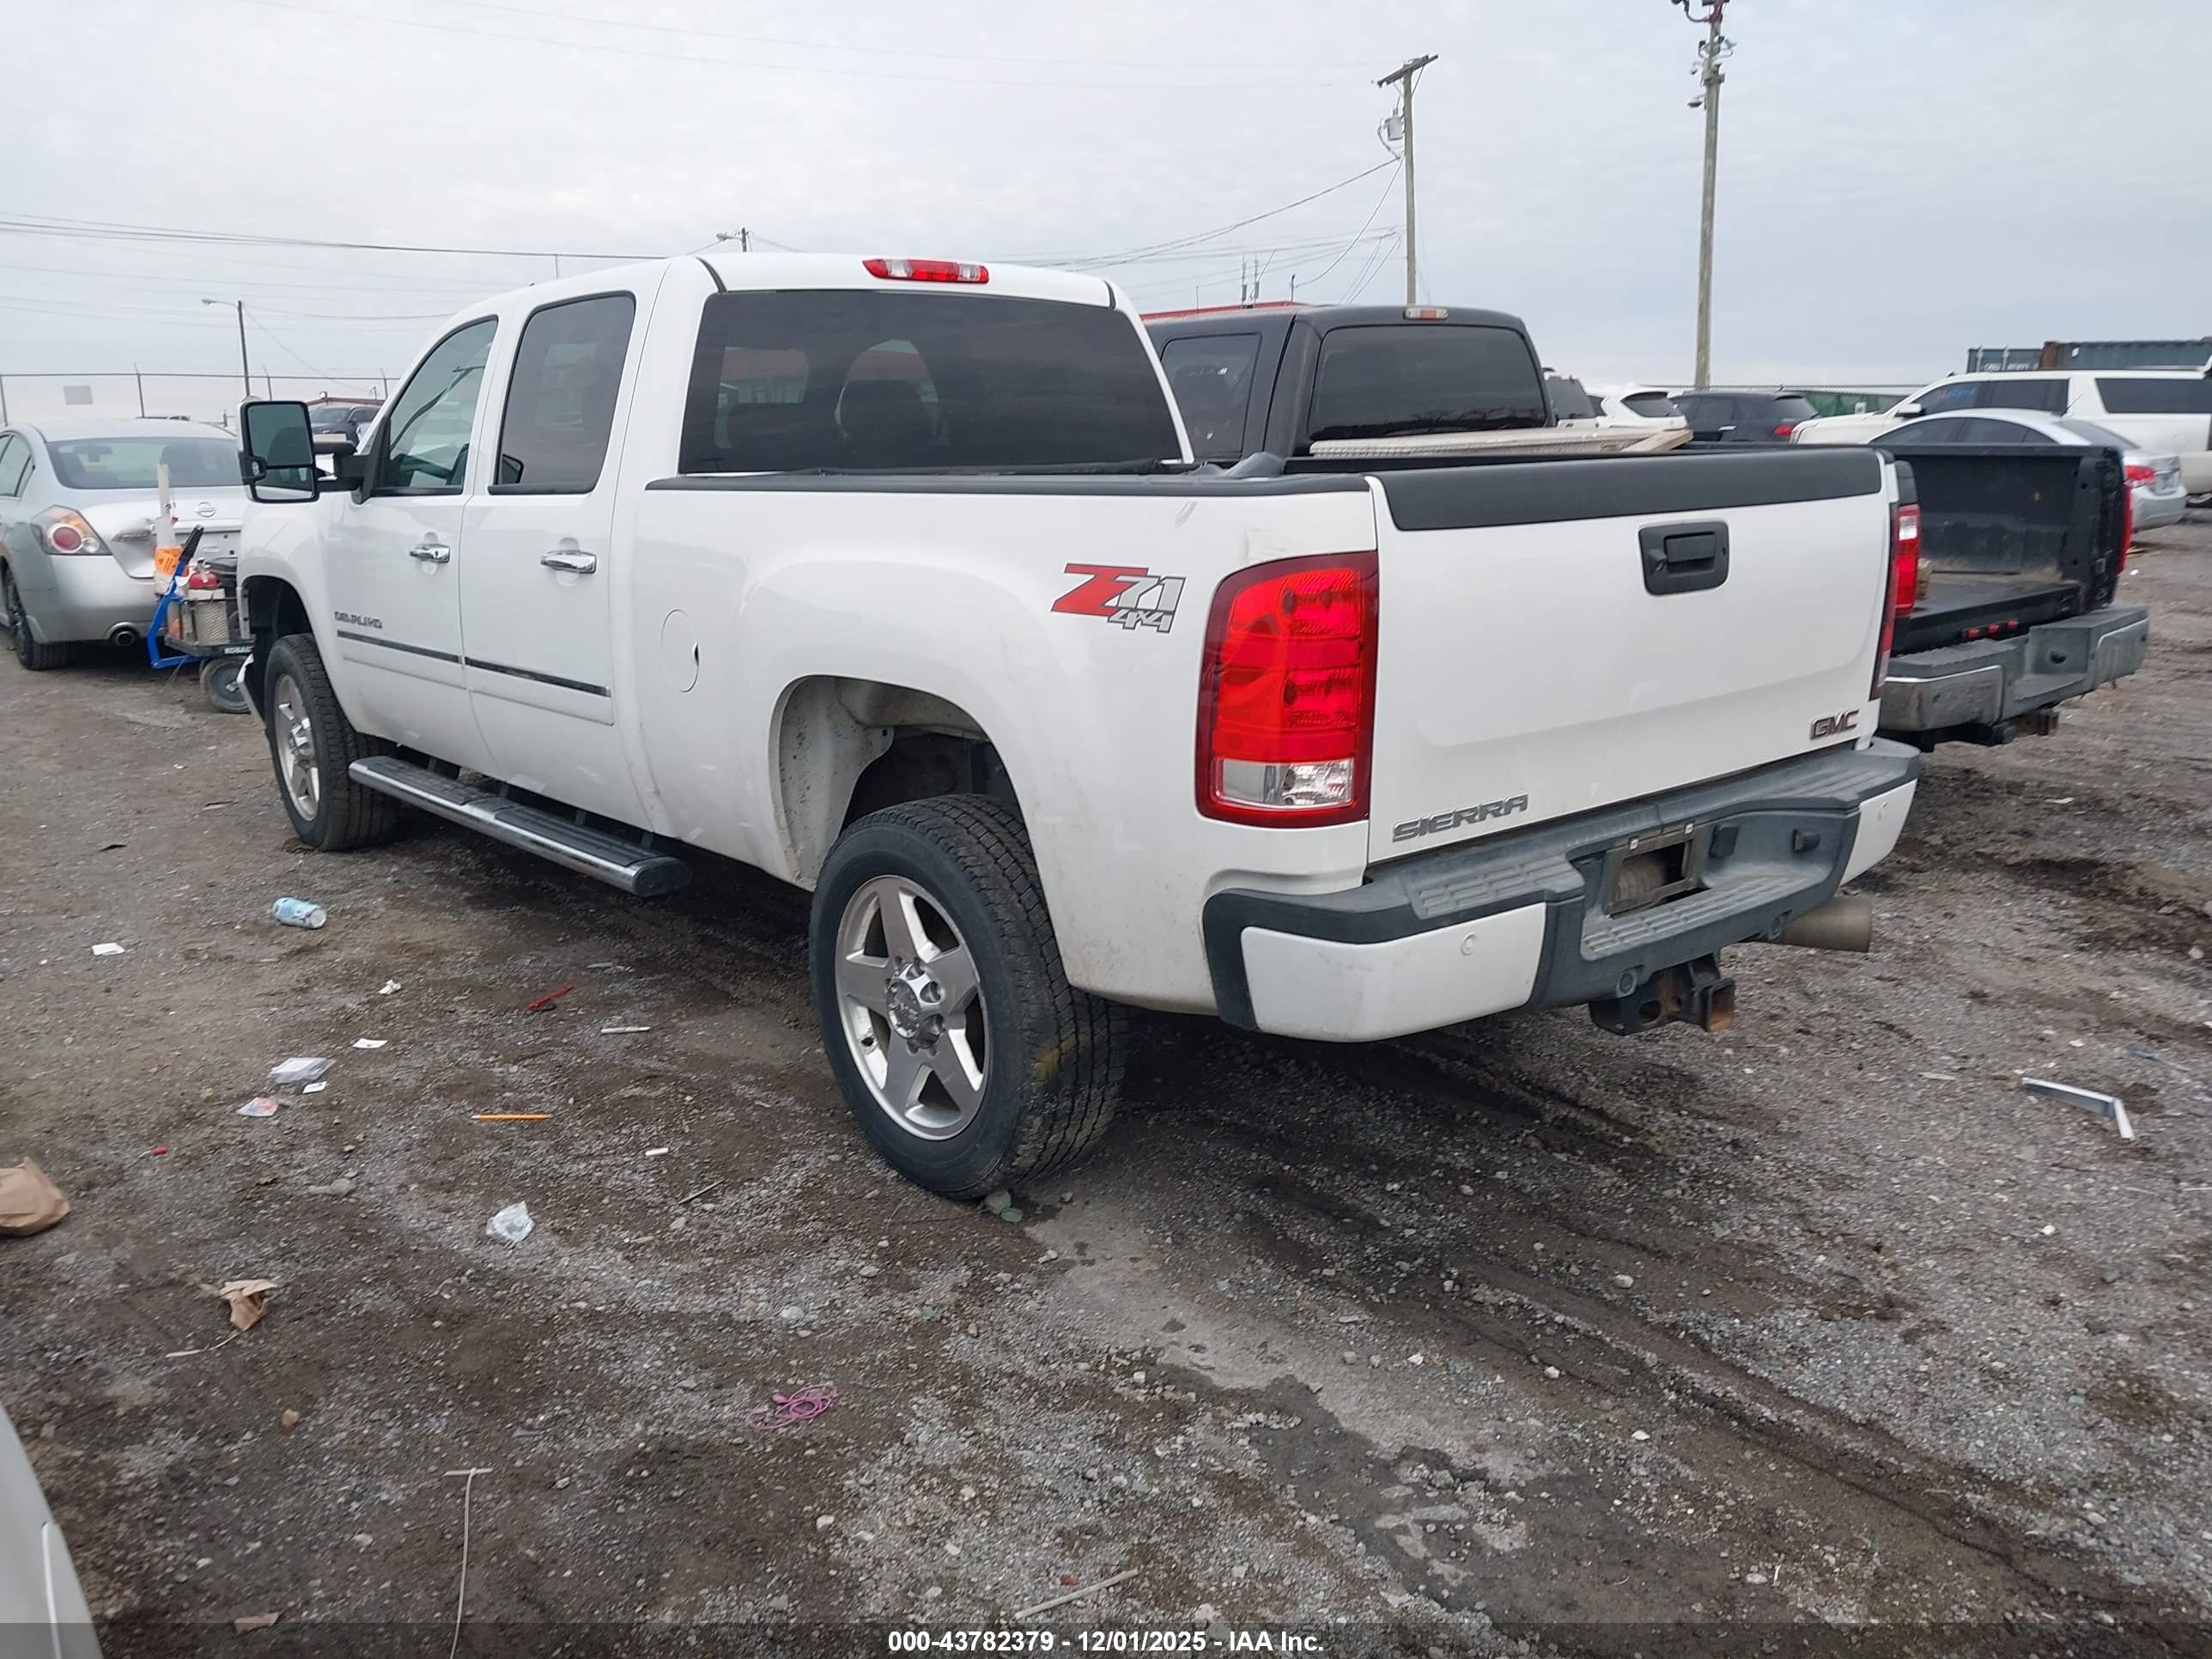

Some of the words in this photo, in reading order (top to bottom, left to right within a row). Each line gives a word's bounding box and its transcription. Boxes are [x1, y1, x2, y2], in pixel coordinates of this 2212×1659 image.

[1050, 562, 1188, 617] Z71
[1809, 708, 1860, 740] GMC
[1392, 792, 1528, 842] SIERRA
